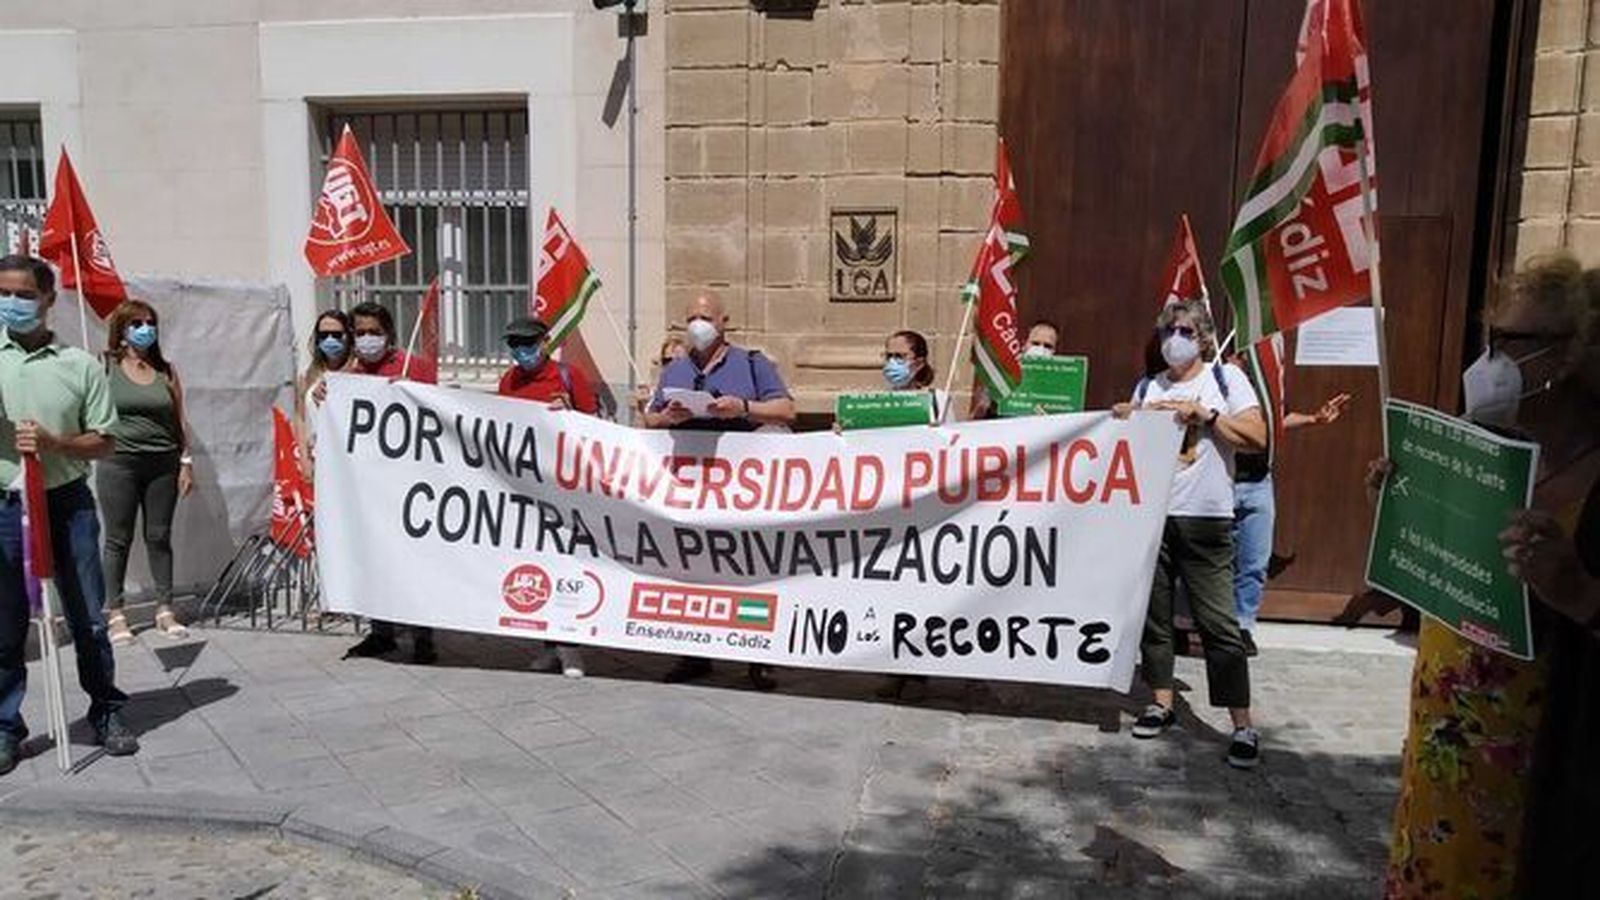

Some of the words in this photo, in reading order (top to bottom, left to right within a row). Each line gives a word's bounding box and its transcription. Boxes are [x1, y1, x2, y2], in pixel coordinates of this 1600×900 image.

[1279, 222, 1330, 299] diz
[347, 399, 444, 464] POR
[455, 414, 543, 483] UNA
[554, 431, 885, 512] UNIVERSIDAD
[902, 434, 1140, 509] PÚBLICA
[403, 482, 599, 557] CONTRA
[604, 515, 668, 567] LA
[673, 510, 1058, 588] PRIVATIZACIÓN
[625, 622, 711, 645] Enseñanza
[725, 631, 772, 650] Cádiz
[636, 589, 732, 621] CCOO
[892, 612, 1112, 665] RECORTE
